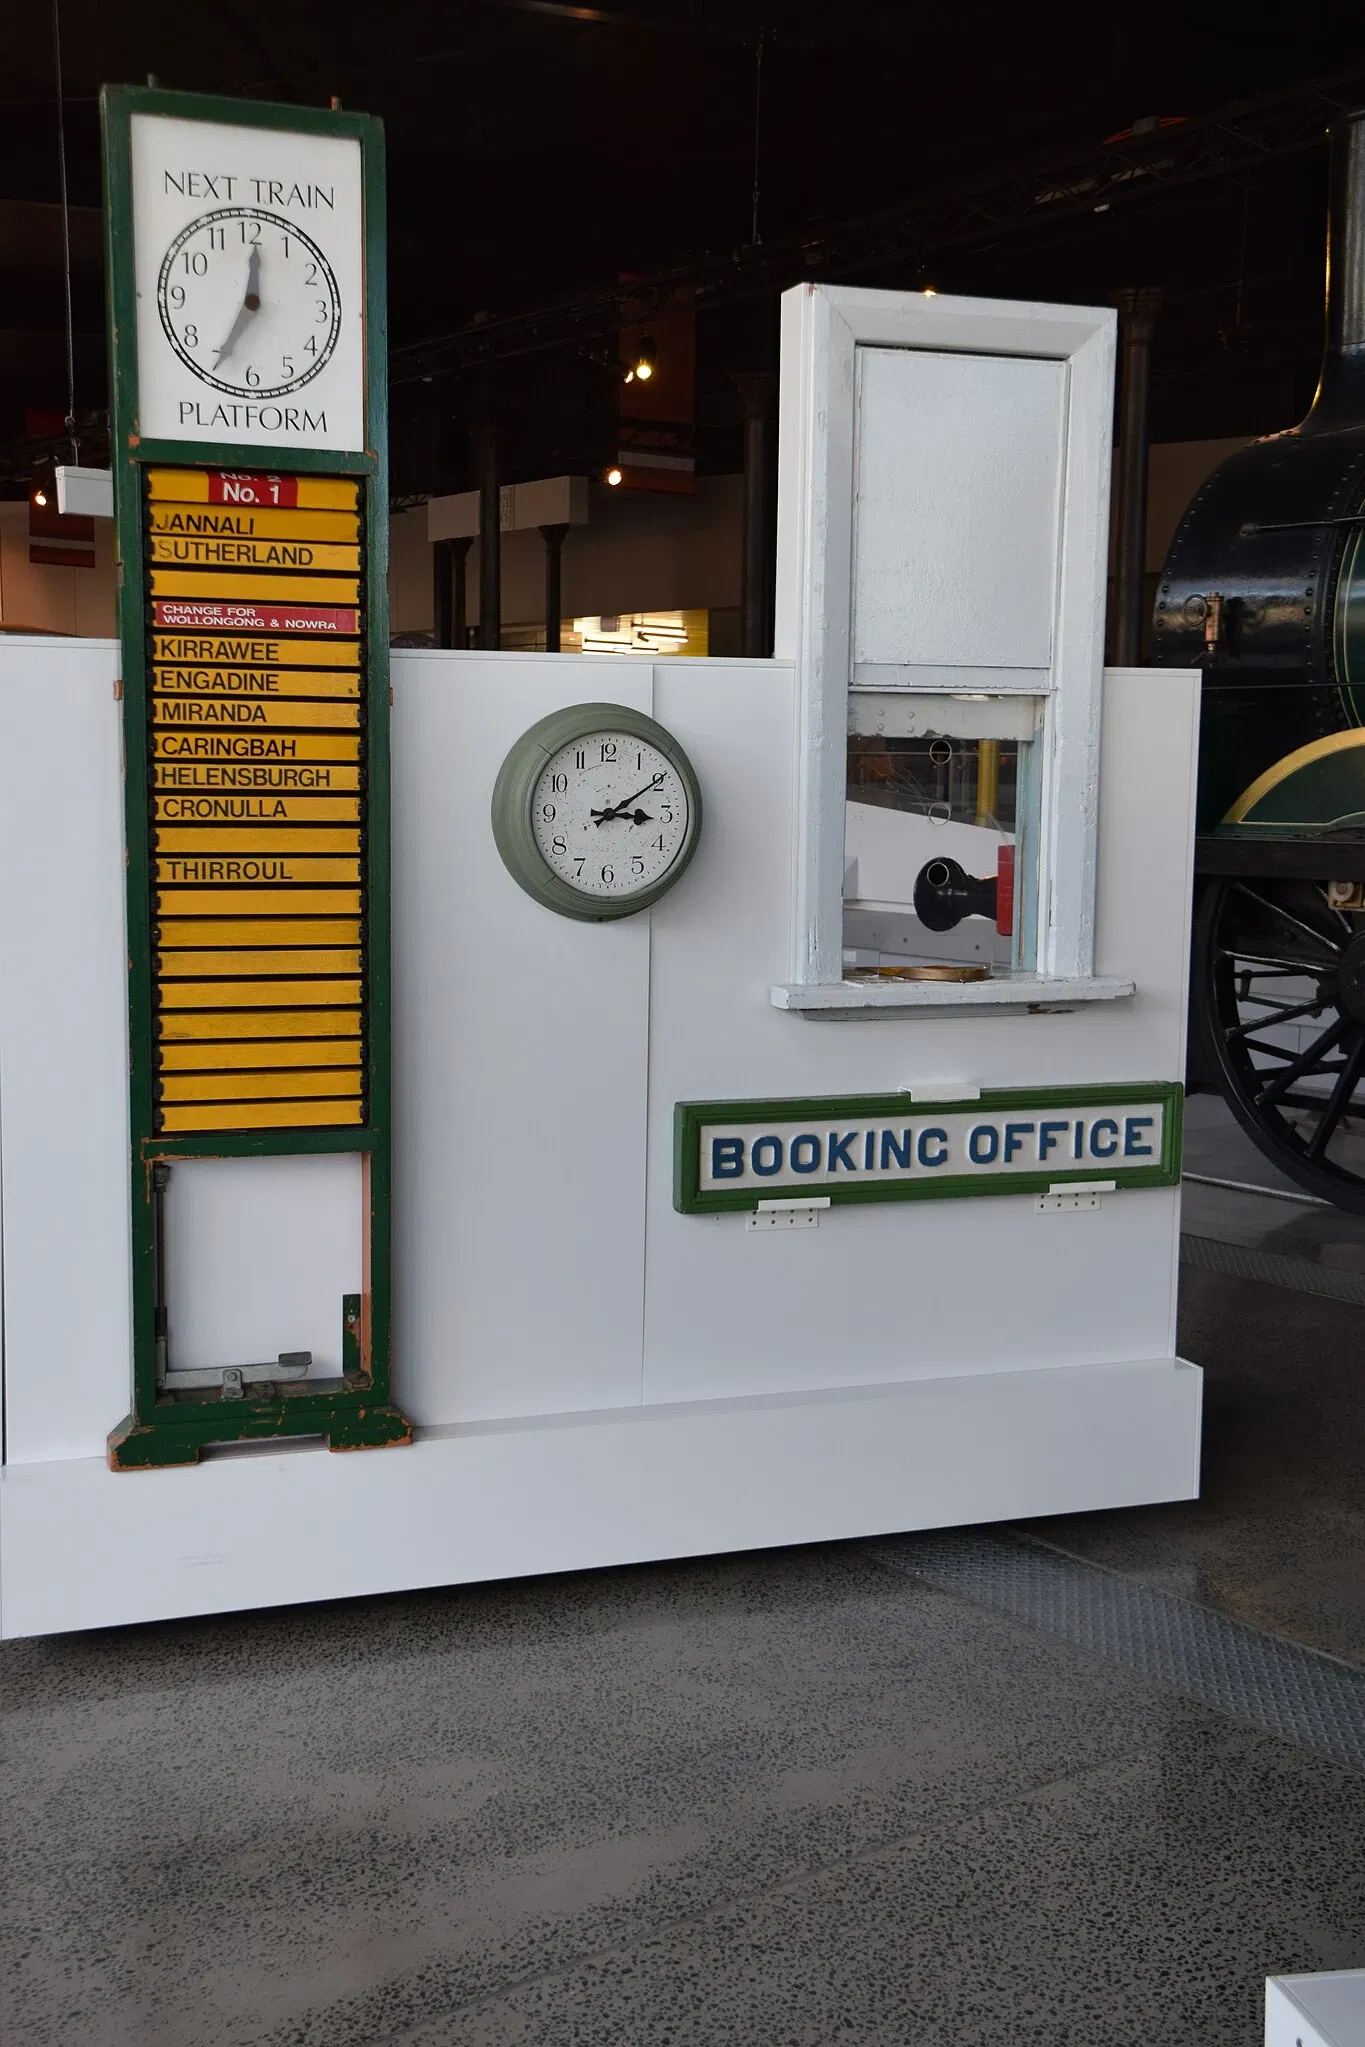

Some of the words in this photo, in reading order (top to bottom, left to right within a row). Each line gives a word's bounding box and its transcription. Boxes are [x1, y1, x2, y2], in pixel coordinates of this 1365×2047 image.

[164, 169, 237, 200] NEXT
[250, 178, 335, 211] TRAIN
[207, 227, 226, 250] 11
[237, 221, 263, 246] 12
[281, 236, 290, 259] 1
[182, 251, 208, 277] 10
[304, 262, 318, 286] 2
[170, 286, 186, 309] 9
[314, 300, 329, 324] 3
[184, 324, 199, 348] 8
[304, 335, 319, 357] 4
[245, 364, 261, 388] 6
[281, 356, 295, 380] 5
[179, 401, 328, 434] PLATFORM
[223, 482, 260, 503] No.
[270, 485, 280, 504] 1
[156, 513, 255, 535] JANNALI
[157, 540, 314, 566] SUTHERLAND
[162, 605, 222, 616] CHANGE
[227, 607, 256, 617] FOR
[163, 615, 265, 628] WOLLONGONG
[270, 618, 280, 628] &
[285, 619, 337, 630] NOWRA
[159, 638, 279, 662] KIRRAWEE
[160, 671, 279, 693] ENGADINE
[161, 702, 267, 723] MIRANDA
[161, 735, 296, 758] CARINGBAH
[600, 742, 617, 763] 12
[575, 750, 586, 770] 11
[636, 752, 643, 771] 1
[161, 766, 331, 788] HELENSBURGH
[551, 773, 568, 793] 10
[652, 772, 665, 792] 2
[162, 798, 288, 819] CRONULLA
[542, 803, 556, 823] 9
[660, 805, 673, 824] 3
[551, 835, 567, 855] 8
[651, 834, 667, 852] 4
[166, 860, 294, 881] THIRROUL
[573, 857, 587, 877] 7
[601, 864, 615, 884] 6
[630, 855, 645, 875] 5
[712, 1127, 949, 1179] BOOKING
[969, 1117, 1153, 1164] OFFICE
